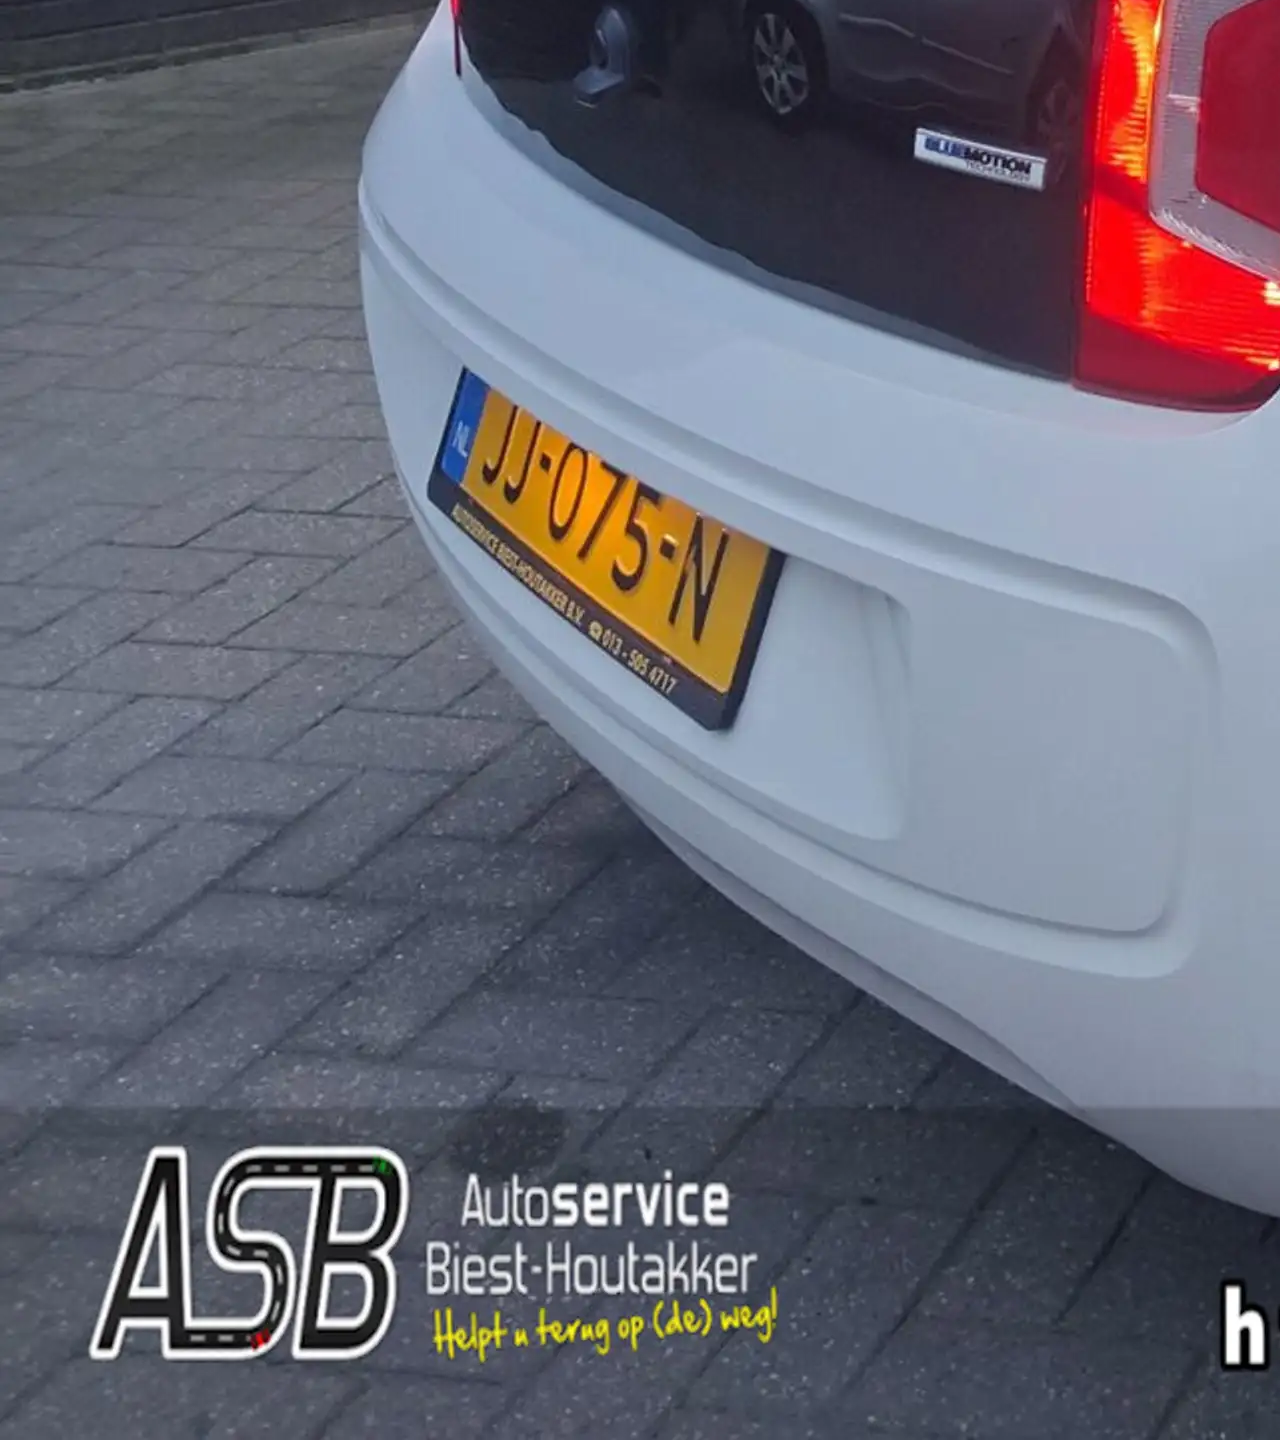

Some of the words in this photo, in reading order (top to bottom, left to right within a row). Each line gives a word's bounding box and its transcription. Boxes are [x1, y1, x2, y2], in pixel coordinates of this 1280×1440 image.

[924, 135, 1032, 175] BLUEMOTION
[481, 404, 730, 644] JJ-075-N
[647, 665, 678, 695] 4717
